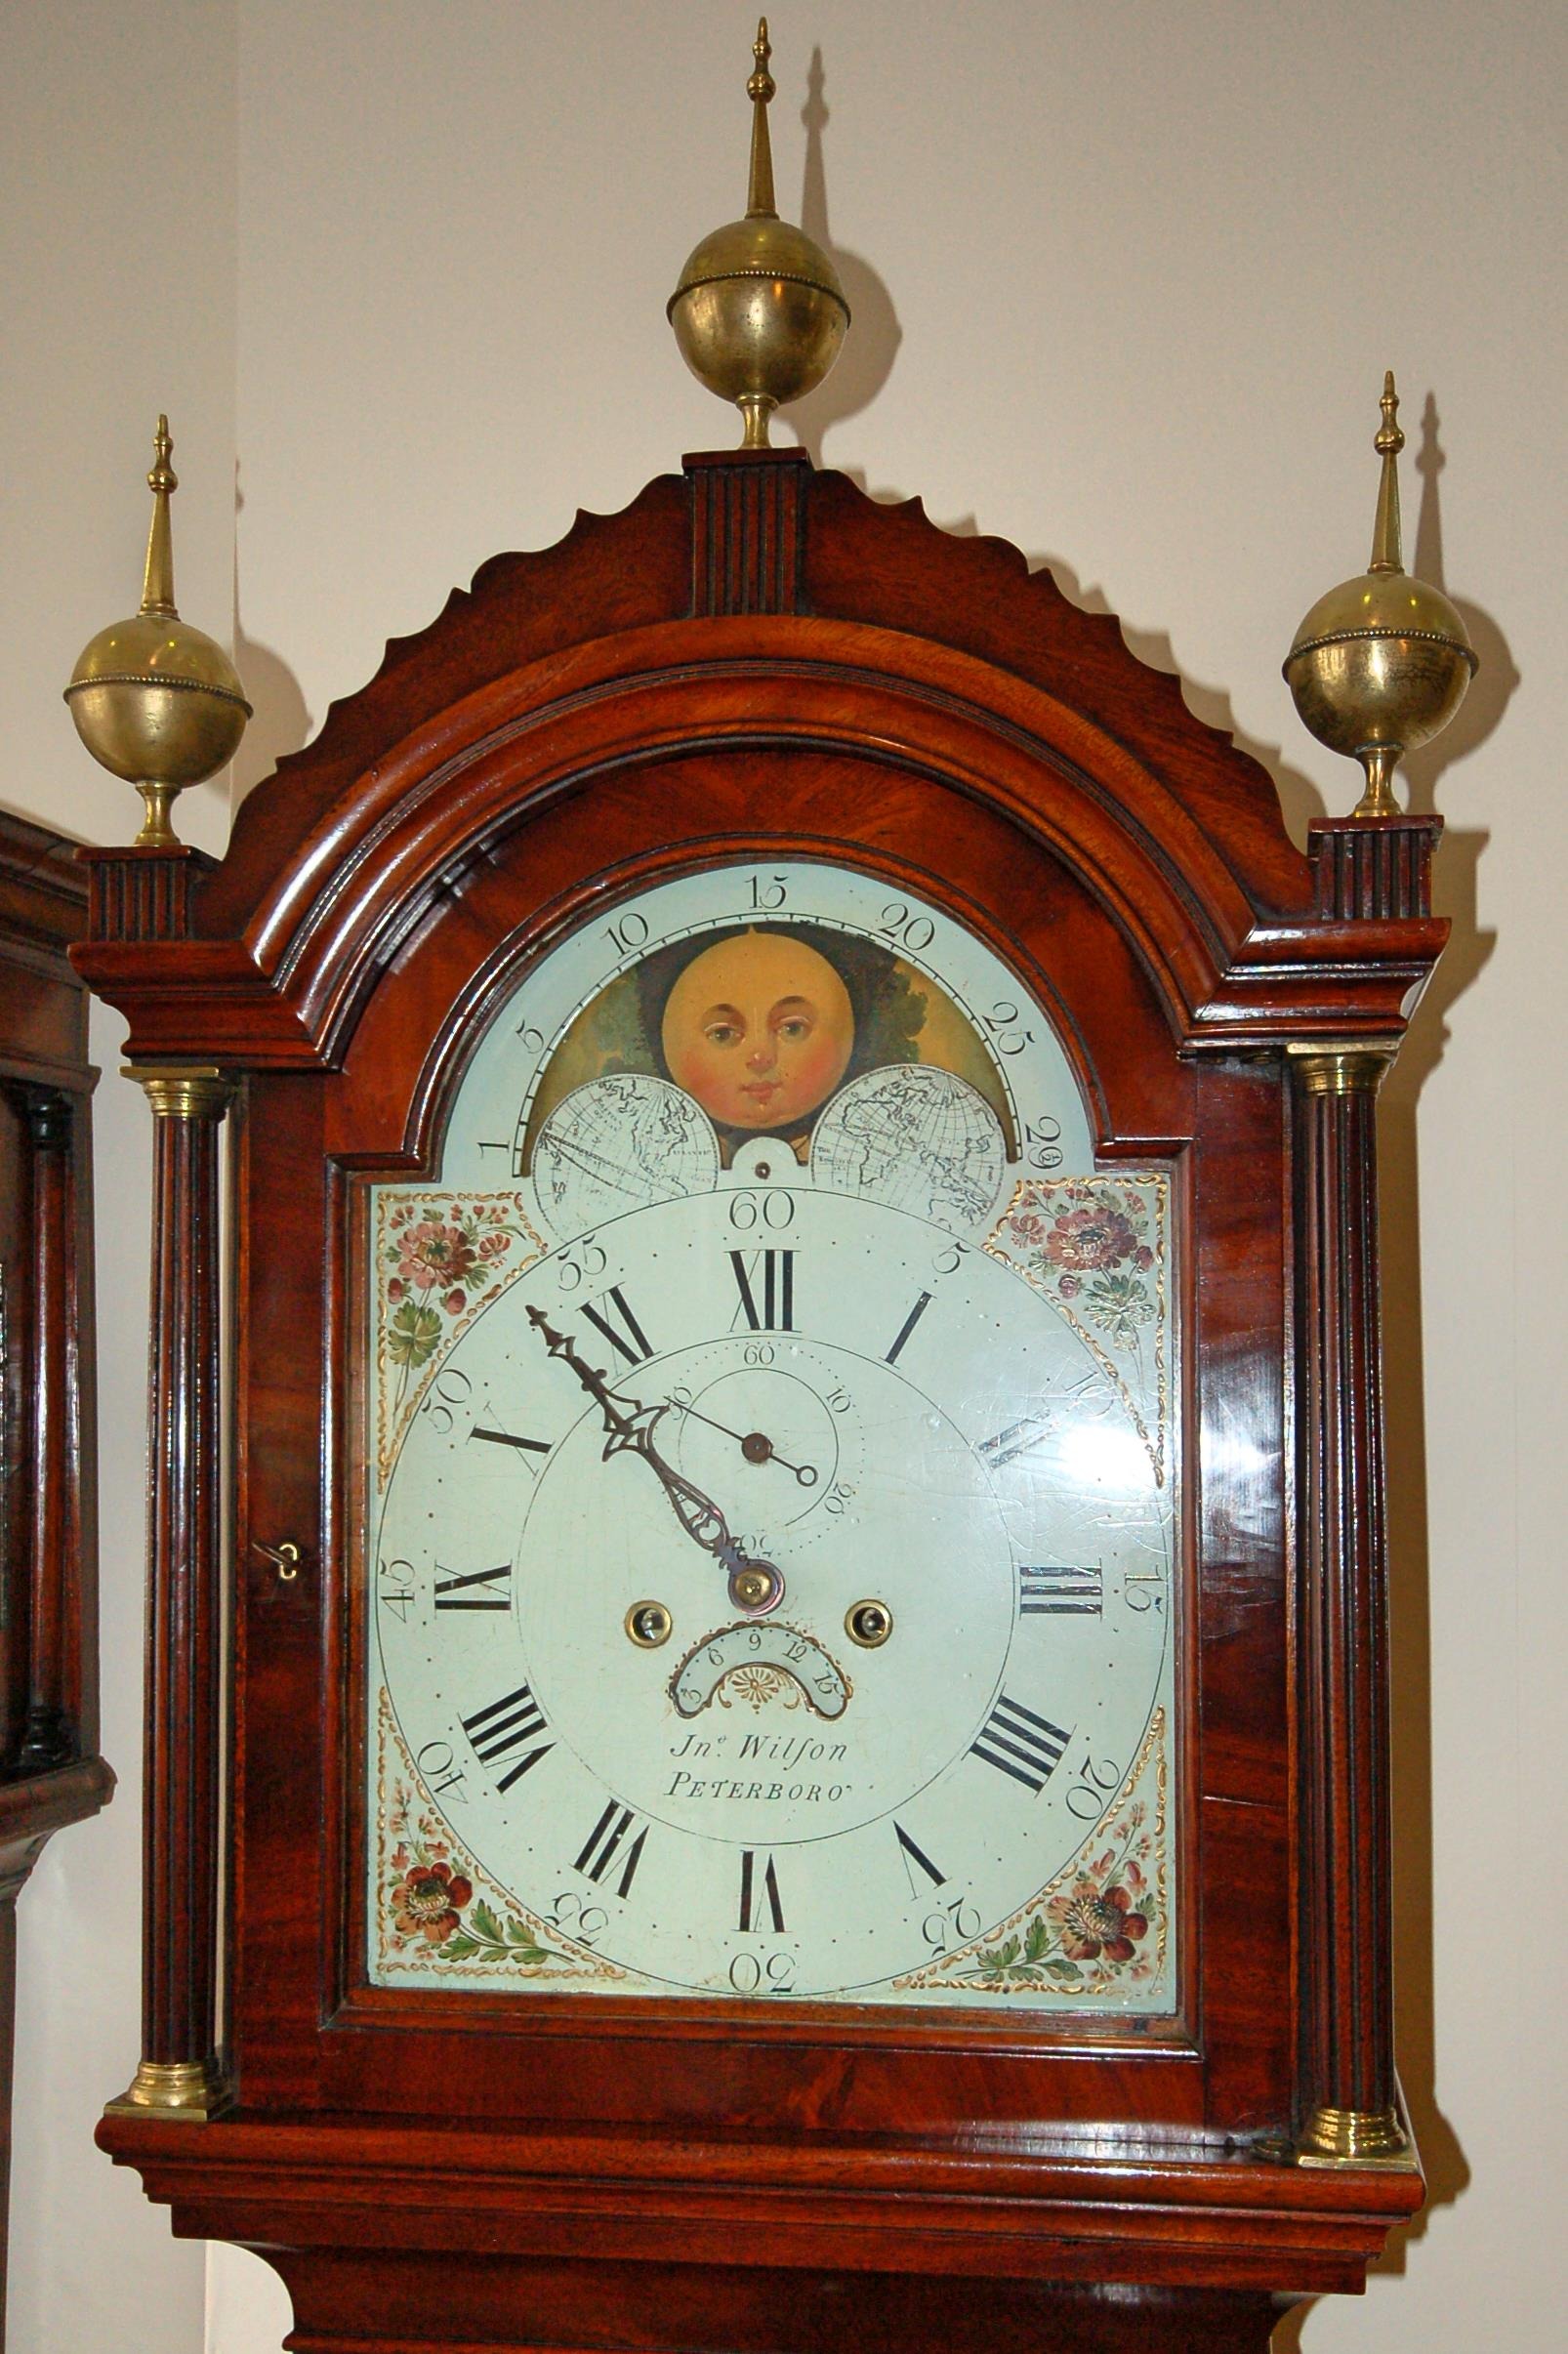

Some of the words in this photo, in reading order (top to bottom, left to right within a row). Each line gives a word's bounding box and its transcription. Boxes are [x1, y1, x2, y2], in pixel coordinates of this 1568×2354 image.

[748, 874, 789, 908] 15
[598, 912, 649, 960] 10
[879, 901, 934, 951] 20
[516, 1019, 545, 1053] 5
[980, 1001, 1026, 1058] 25
[476, 1140, 510, 1155] 1
[729, 1191, 795, 1230] 60
[557, 1233, 607, 1292] 55
[931, 1242, 970, 1274] 5
[723, 1249, 802, 1334] XII
[576, 1281, 662, 1379] XI
[744, 1345, 774, 1365] 60
[421, 1368, 473, 1434] 50
[826, 1387, 850, 1413] 10
[467, 1401, 556, 1479] X
[824, 1483, 851, 1514] 20
[380, 1559, 416, 1624] 45
[434, 1559, 512, 1620] IX
[1018, 1557, 1103, 1622] III
[1125, 1563, 1165, 1614] 15
[708, 1648, 724, 1666] 6
[749, 1633, 762, 1651] 9
[782, 1640, 807, 1663] 12
[683, 1689, 702, 1704] 3
[812, 1672, 841, 1695] 15
[457, 1677, 557, 1794] VIII
[961, 1681, 1077, 1798] IIII
[417, 1741, 469, 1804] 40
[1065, 1755, 1121, 1821] 20
[569, 1796, 650, 1901] VII
[893, 1820, 953, 1901] V
[731, 1850, 797, 1933] VI
[545, 1892, 609, 1947] 35
[922, 1896, 981, 1957] 25
[728, 1953, 797, 1994] 30
